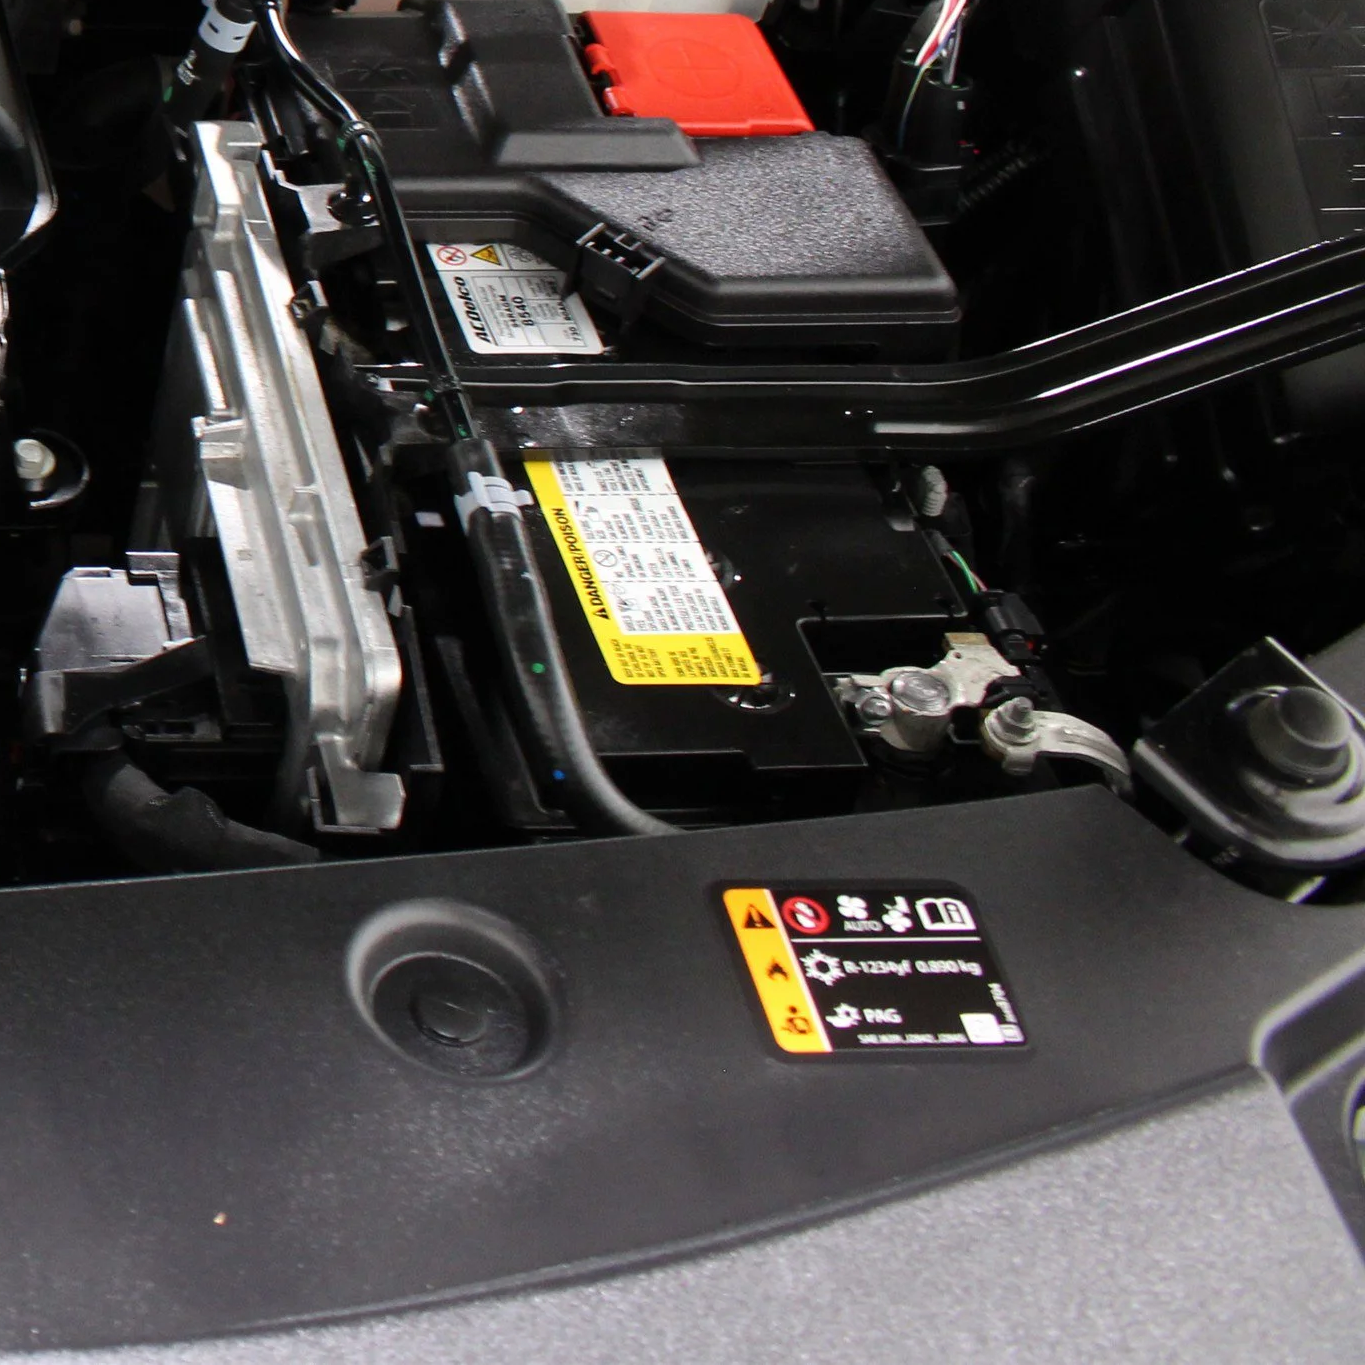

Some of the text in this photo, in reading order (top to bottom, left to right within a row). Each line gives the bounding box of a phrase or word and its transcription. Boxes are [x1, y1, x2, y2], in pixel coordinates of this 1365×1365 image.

[454, 276, 492, 344] ACDelco
[551, 507, 607, 606] DANGER/POISON
[843, 919, 884, 932] AUTO
[843, 958, 913, 977] R-1234yf
[863, 1008, 903, 1024] PAG
